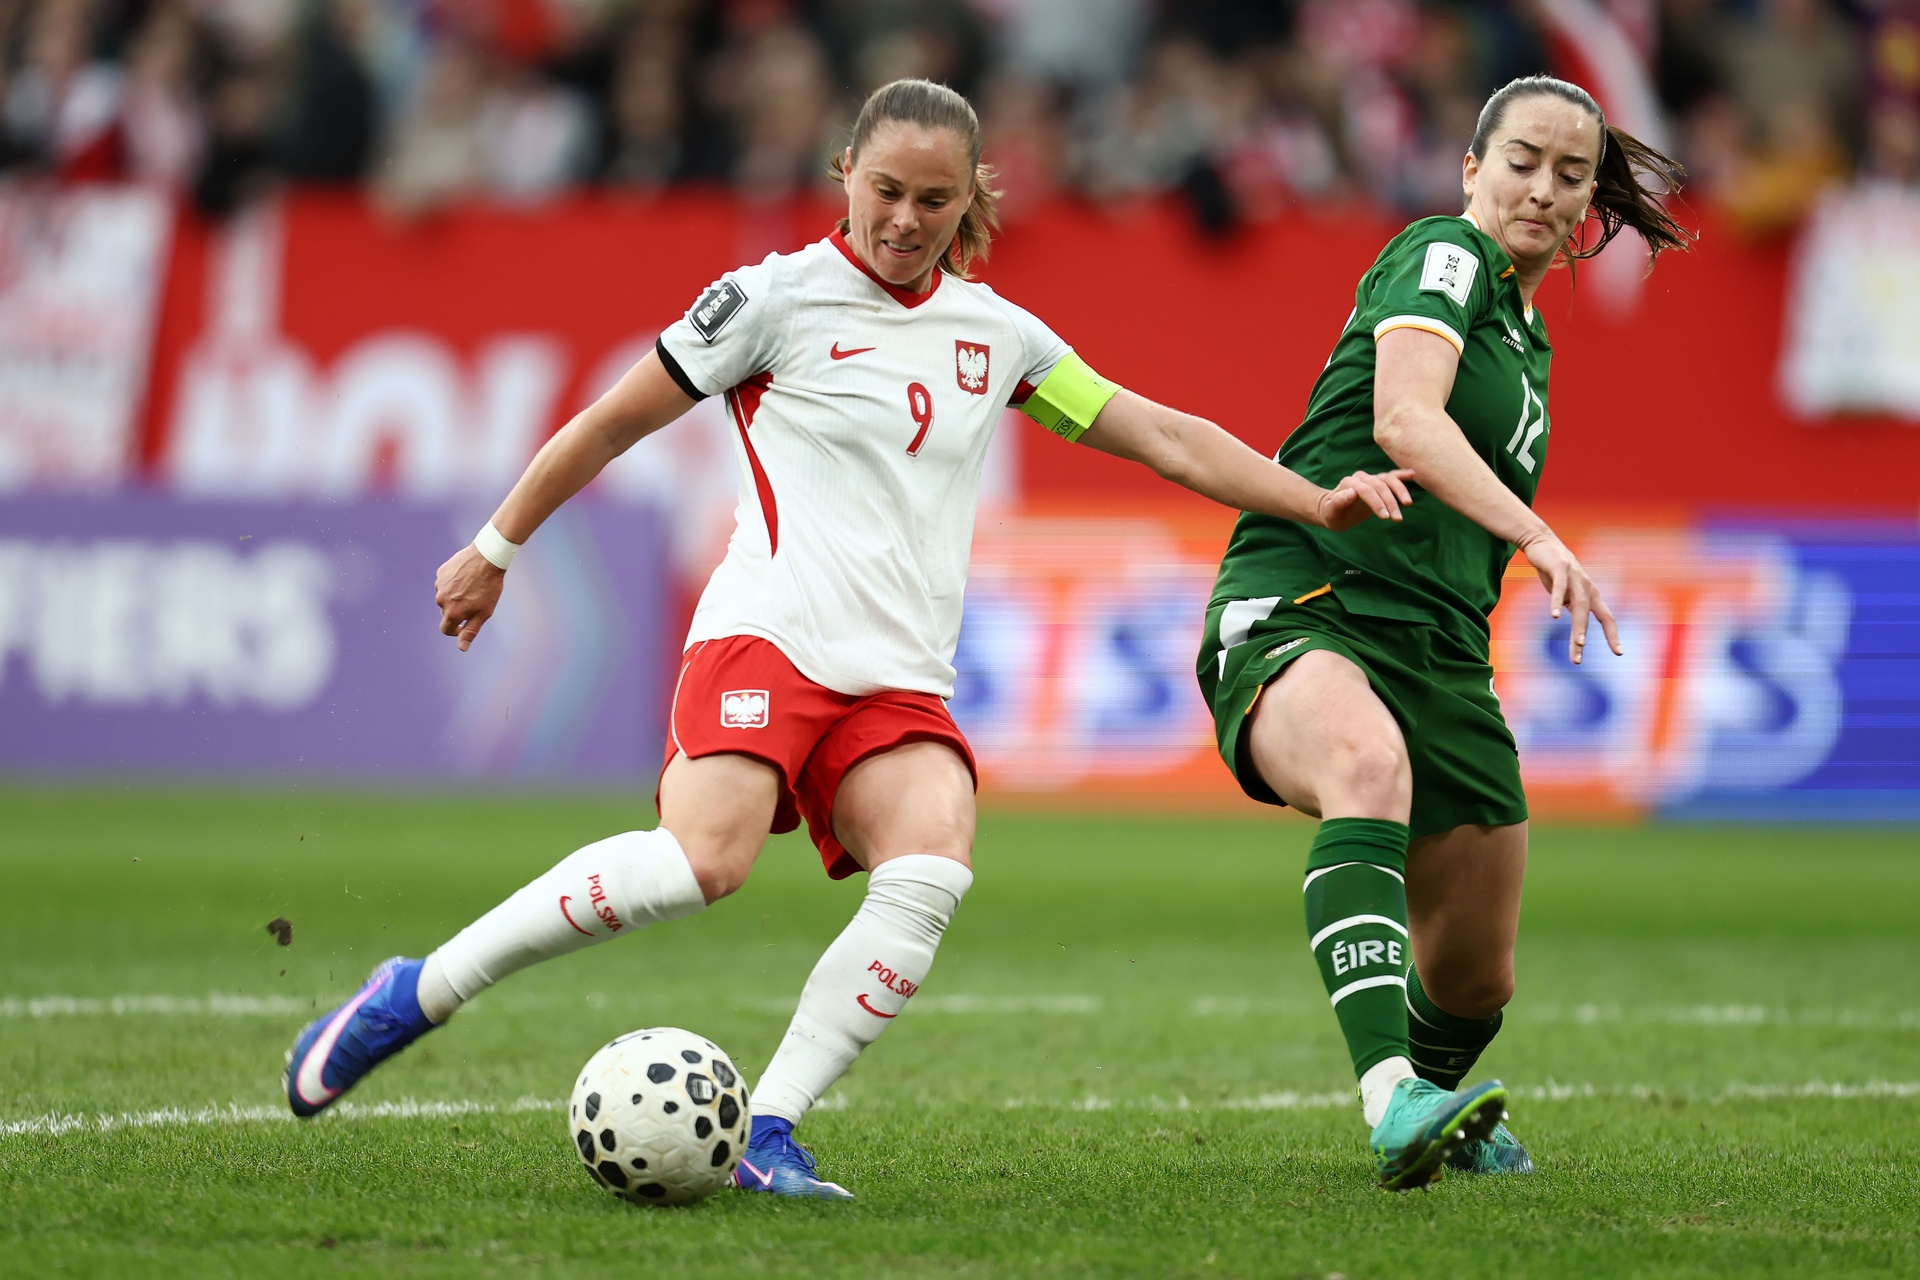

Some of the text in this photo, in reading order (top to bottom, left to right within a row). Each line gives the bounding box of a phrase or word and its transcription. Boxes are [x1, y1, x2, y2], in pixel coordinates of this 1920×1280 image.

[906, 382, 935, 457] 9
[1505, 371, 1544, 475] 12
[587, 873, 623, 932] POLSKA
[1331, 940, 1402, 976] ÉIRE
